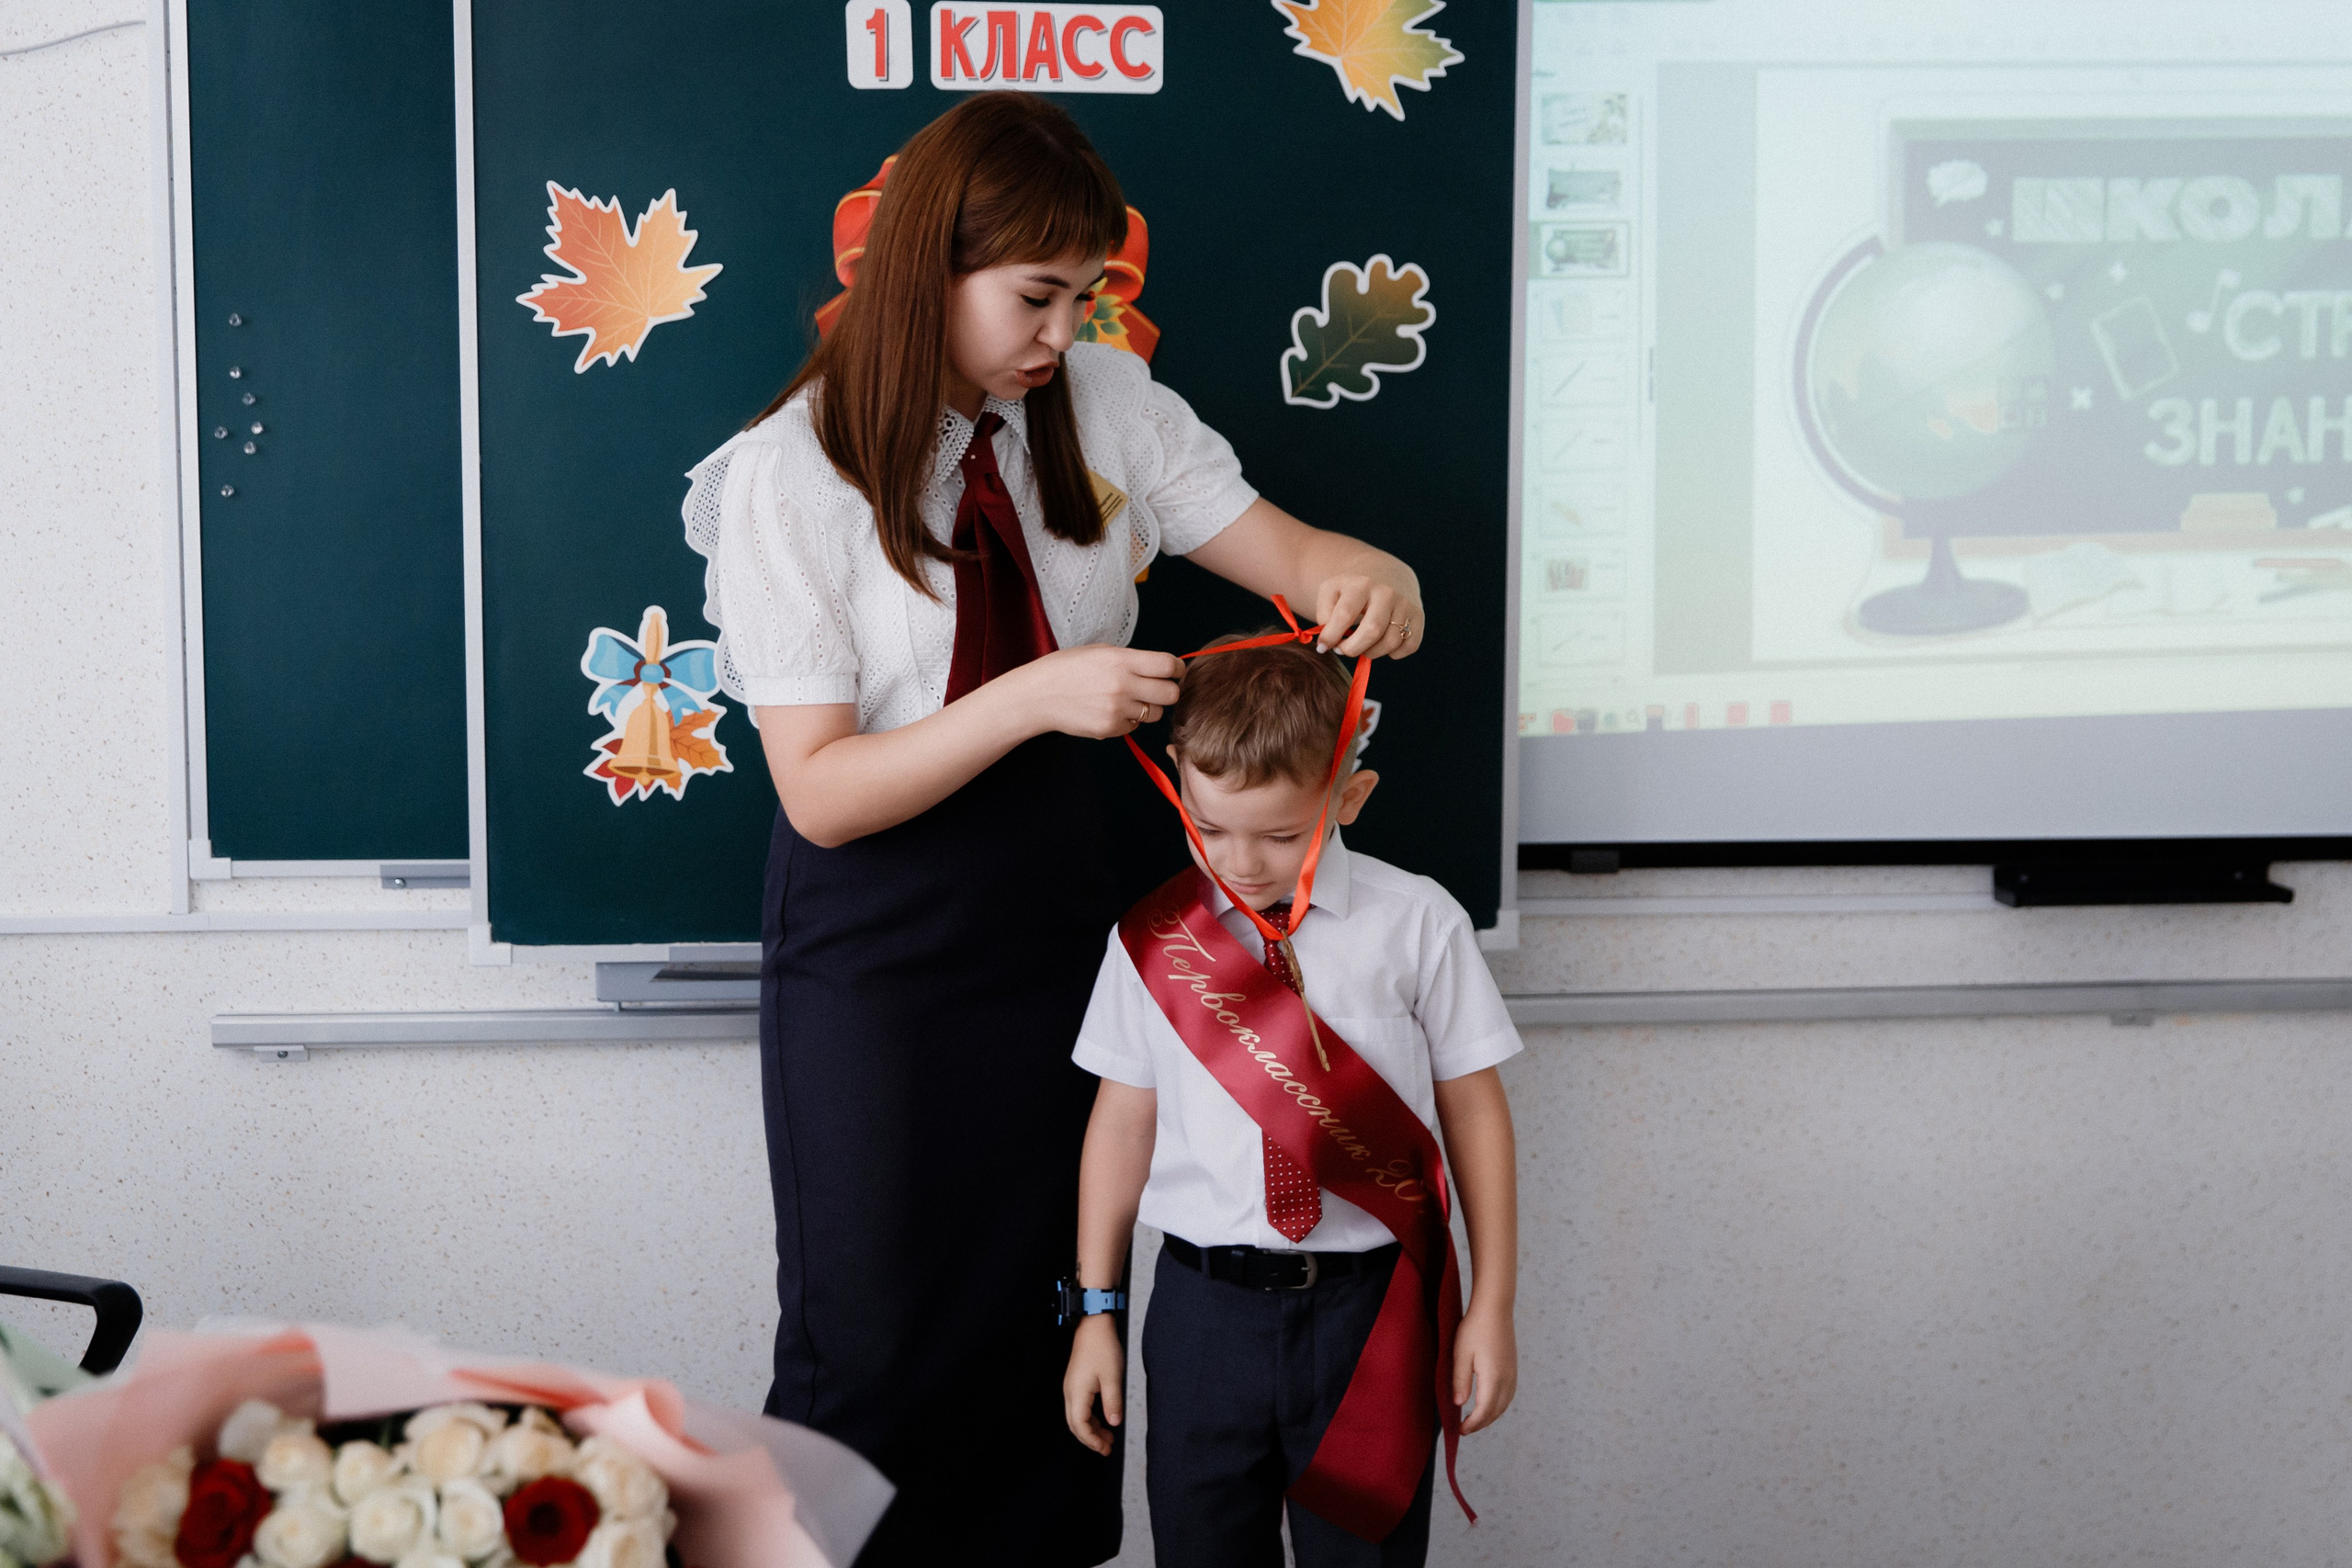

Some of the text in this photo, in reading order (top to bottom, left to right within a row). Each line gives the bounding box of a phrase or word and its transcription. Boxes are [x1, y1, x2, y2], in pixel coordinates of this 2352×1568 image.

[865, 8, 1156, 81] 1 КЛАСС
[2012, 175, 2352, 243] ШКОЛ
[1148, 906, 1425, 1201] Первоклассник 20
